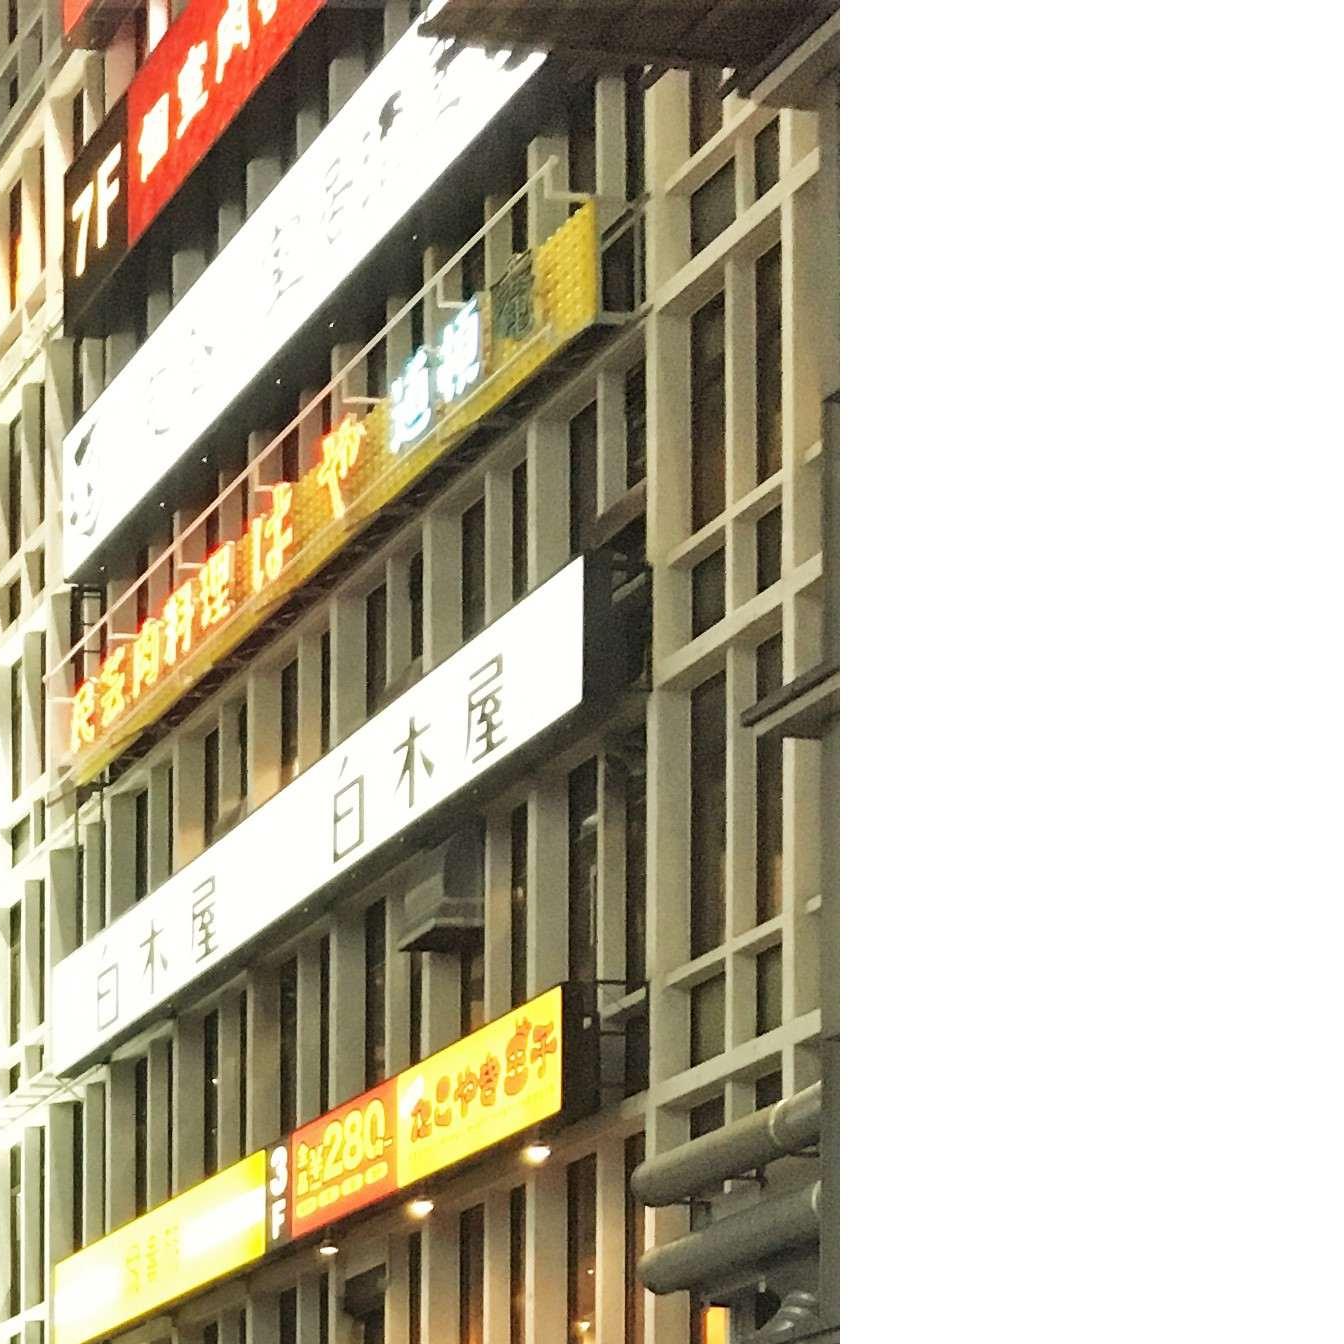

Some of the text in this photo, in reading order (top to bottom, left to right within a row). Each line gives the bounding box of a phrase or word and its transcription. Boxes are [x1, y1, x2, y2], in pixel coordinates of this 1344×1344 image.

[71, 142, 122, 278] 7F
[332, 654, 509, 865] 白木屋
[95, 875, 216, 1032] 白木屋
